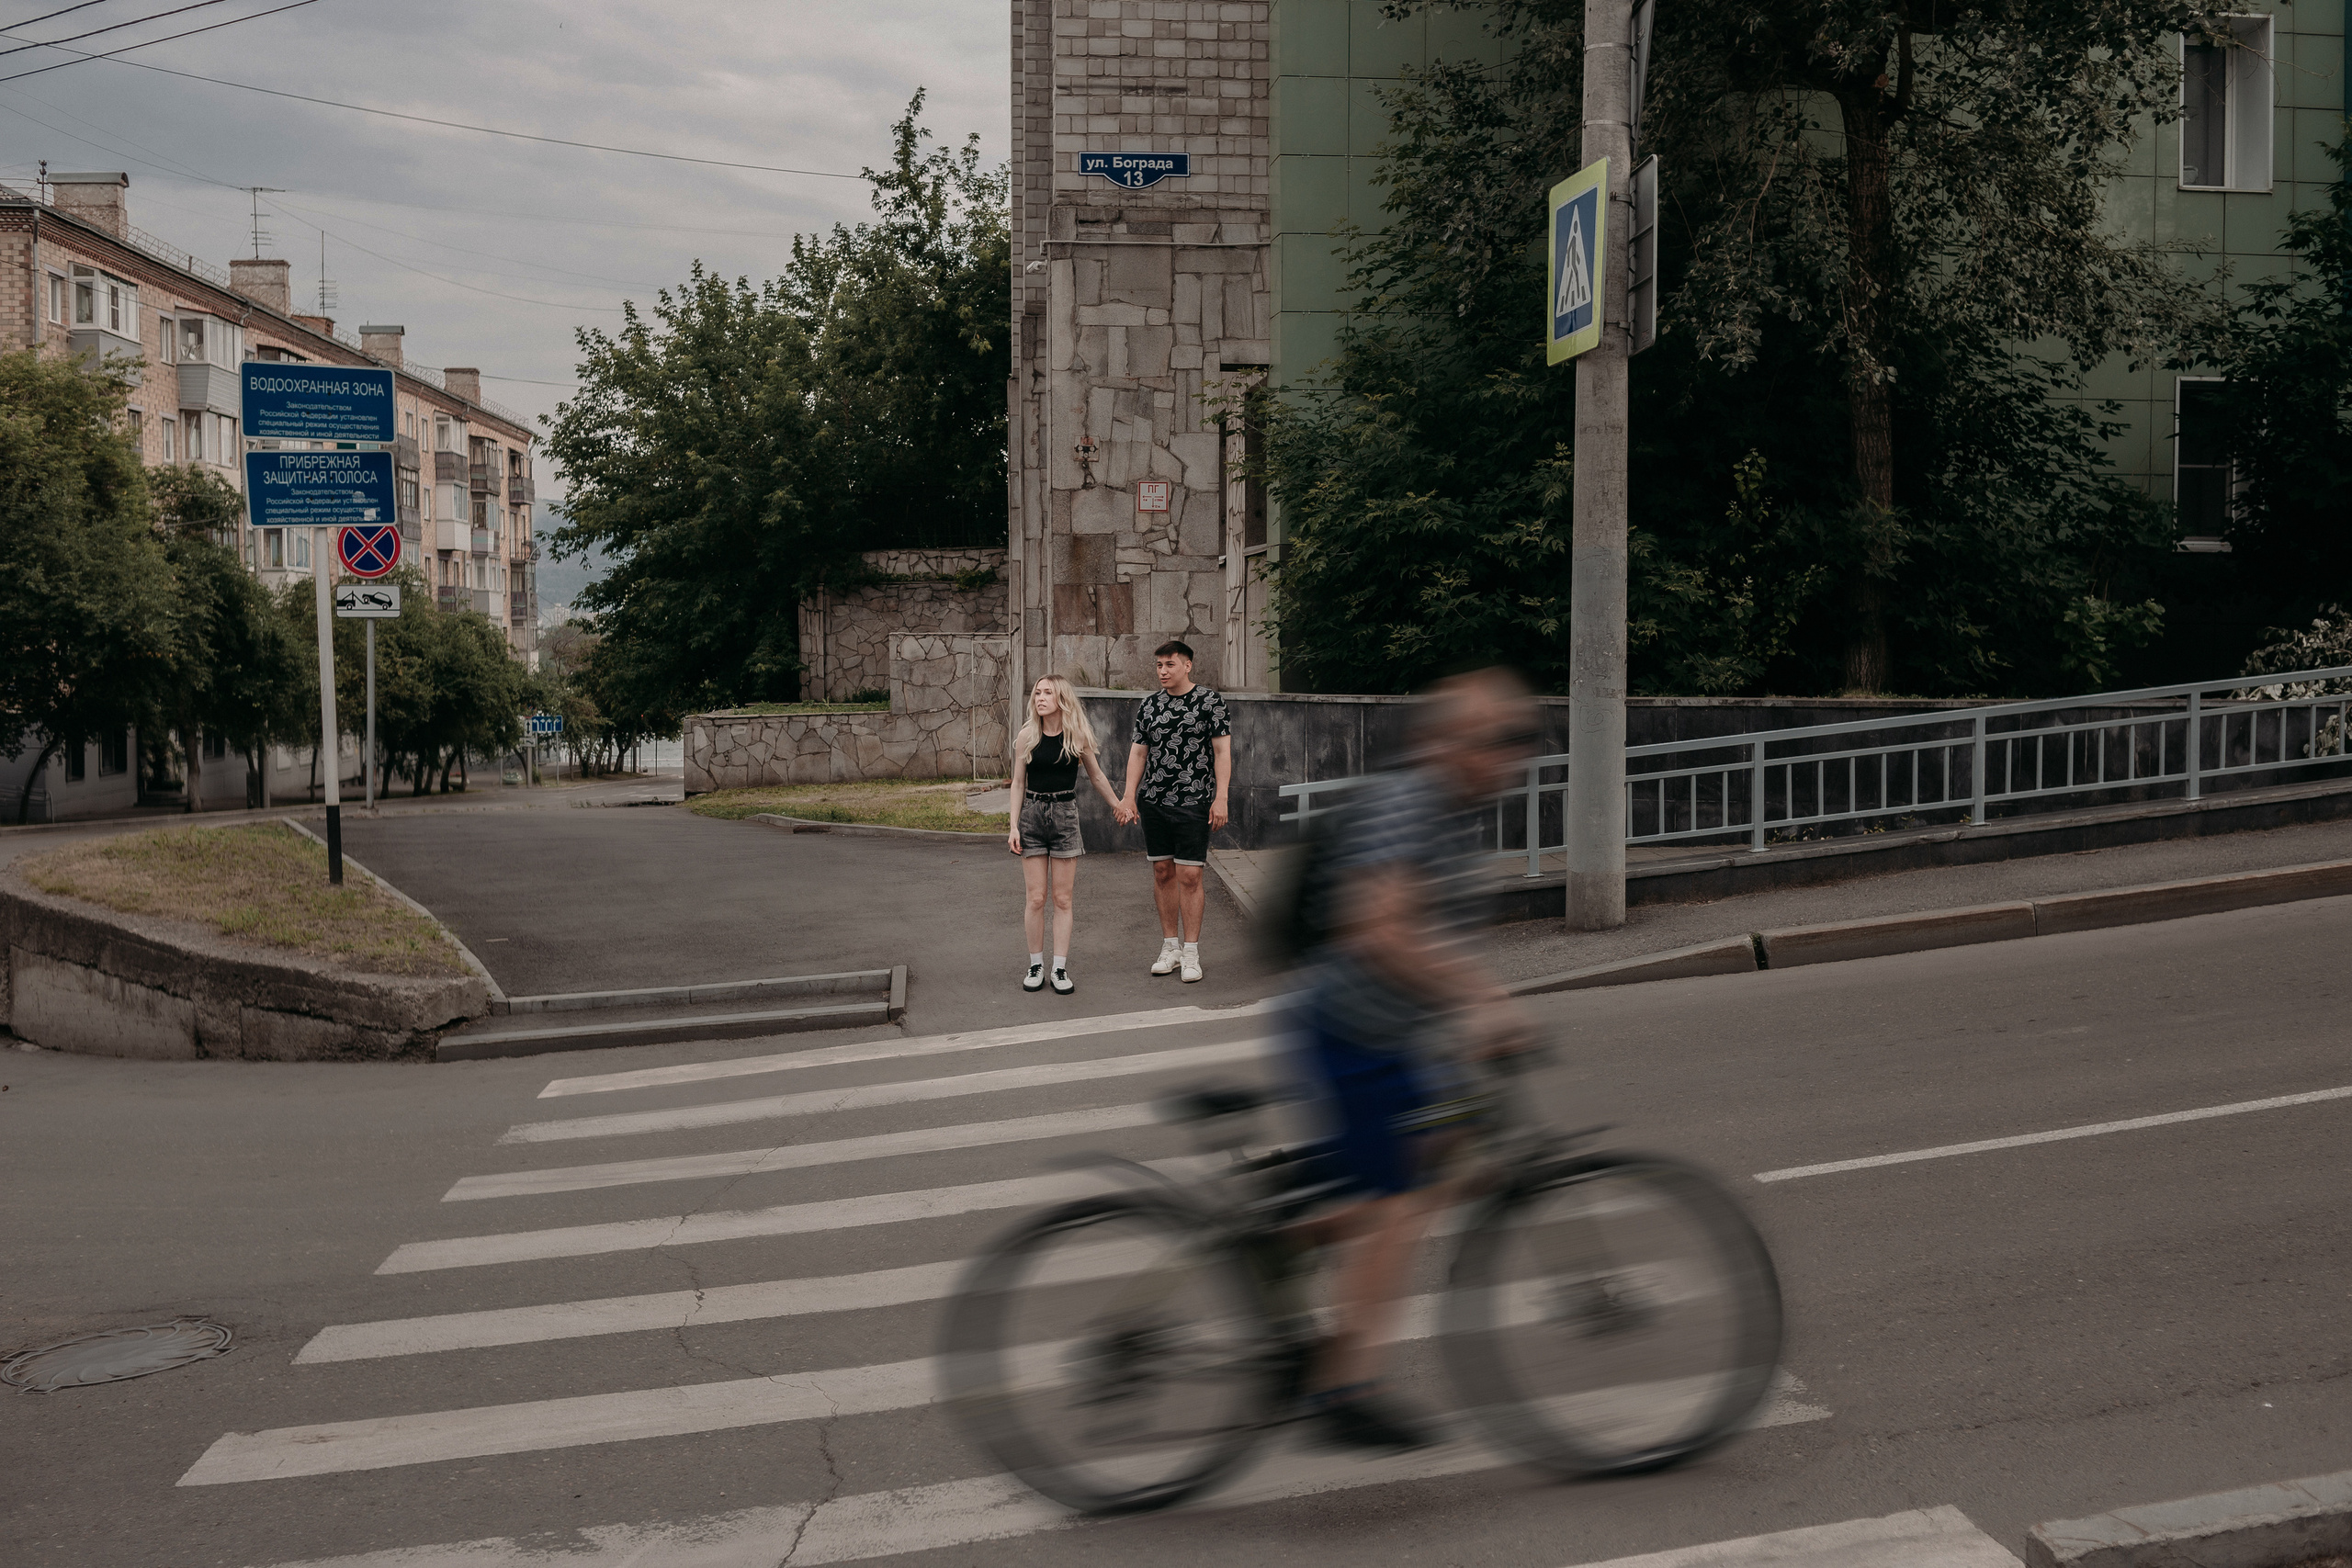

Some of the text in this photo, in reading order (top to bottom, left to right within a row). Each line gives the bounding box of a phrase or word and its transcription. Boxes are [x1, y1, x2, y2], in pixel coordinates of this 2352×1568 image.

[1086, 156, 1173, 171] ул. Бограда
[1124, 171, 1144, 186] 13
[250, 377, 385, 397] ВОДООХРАННАЯ ЗОНА
[286, 401, 352, 412] Законодательством
[259, 409, 300, 418] Российской
[300, 411, 339, 420] Федерации
[258, 428, 310, 436] хозяйственной
[328, 423, 379, 431] осуществления
[279, 456, 360, 469] ПРИБРЕЖНАЯ
[263, 470, 379, 487] ЗАЩИТНАЯ ПОЛОСА
[291, 488, 354, 496] Законодательством
[1148, 485, 1159, 493] ПГ
[305, 497, 342, 505] Федерации
[265, 506, 309, 514] специальный
[266, 515, 314, 524] хозяйственной
